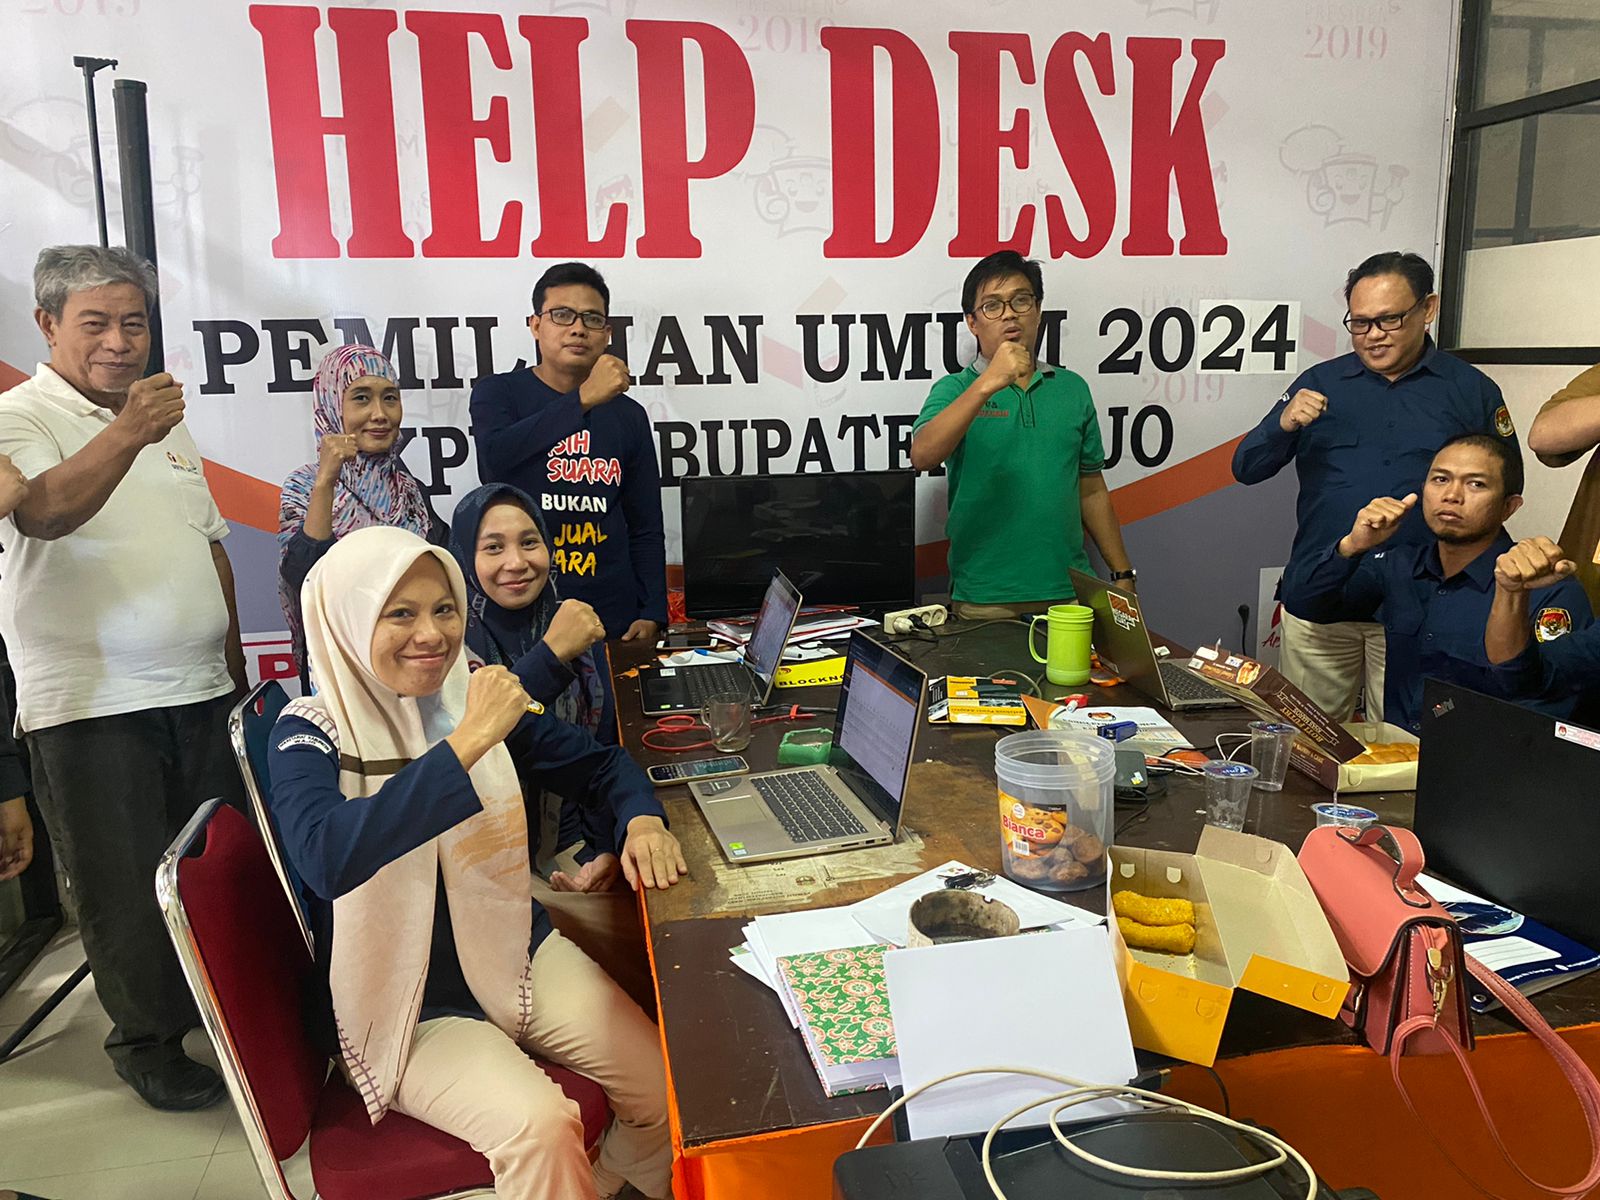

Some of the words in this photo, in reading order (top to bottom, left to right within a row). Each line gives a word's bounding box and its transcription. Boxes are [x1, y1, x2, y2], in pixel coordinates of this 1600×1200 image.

[1303, 24, 1388, 60] 2019
[249, 4, 756, 258] HELP
[821, 28, 1228, 259] DESK
[192, 313, 763, 394] PEMILAN
[1098, 304, 1296, 375] 2024
[395, 426, 481, 495] KP
[653, 414, 946, 488] BUPATE
[1103, 404, 1174, 470] JO
[547, 457, 621, 486] SUARA
[541, 493, 607, 512] BUKAN
[554, 522, 608, 547] JUAL
[555, 549, 597, 577] ARA
[1002, 814, 1044, 839] Bianca
